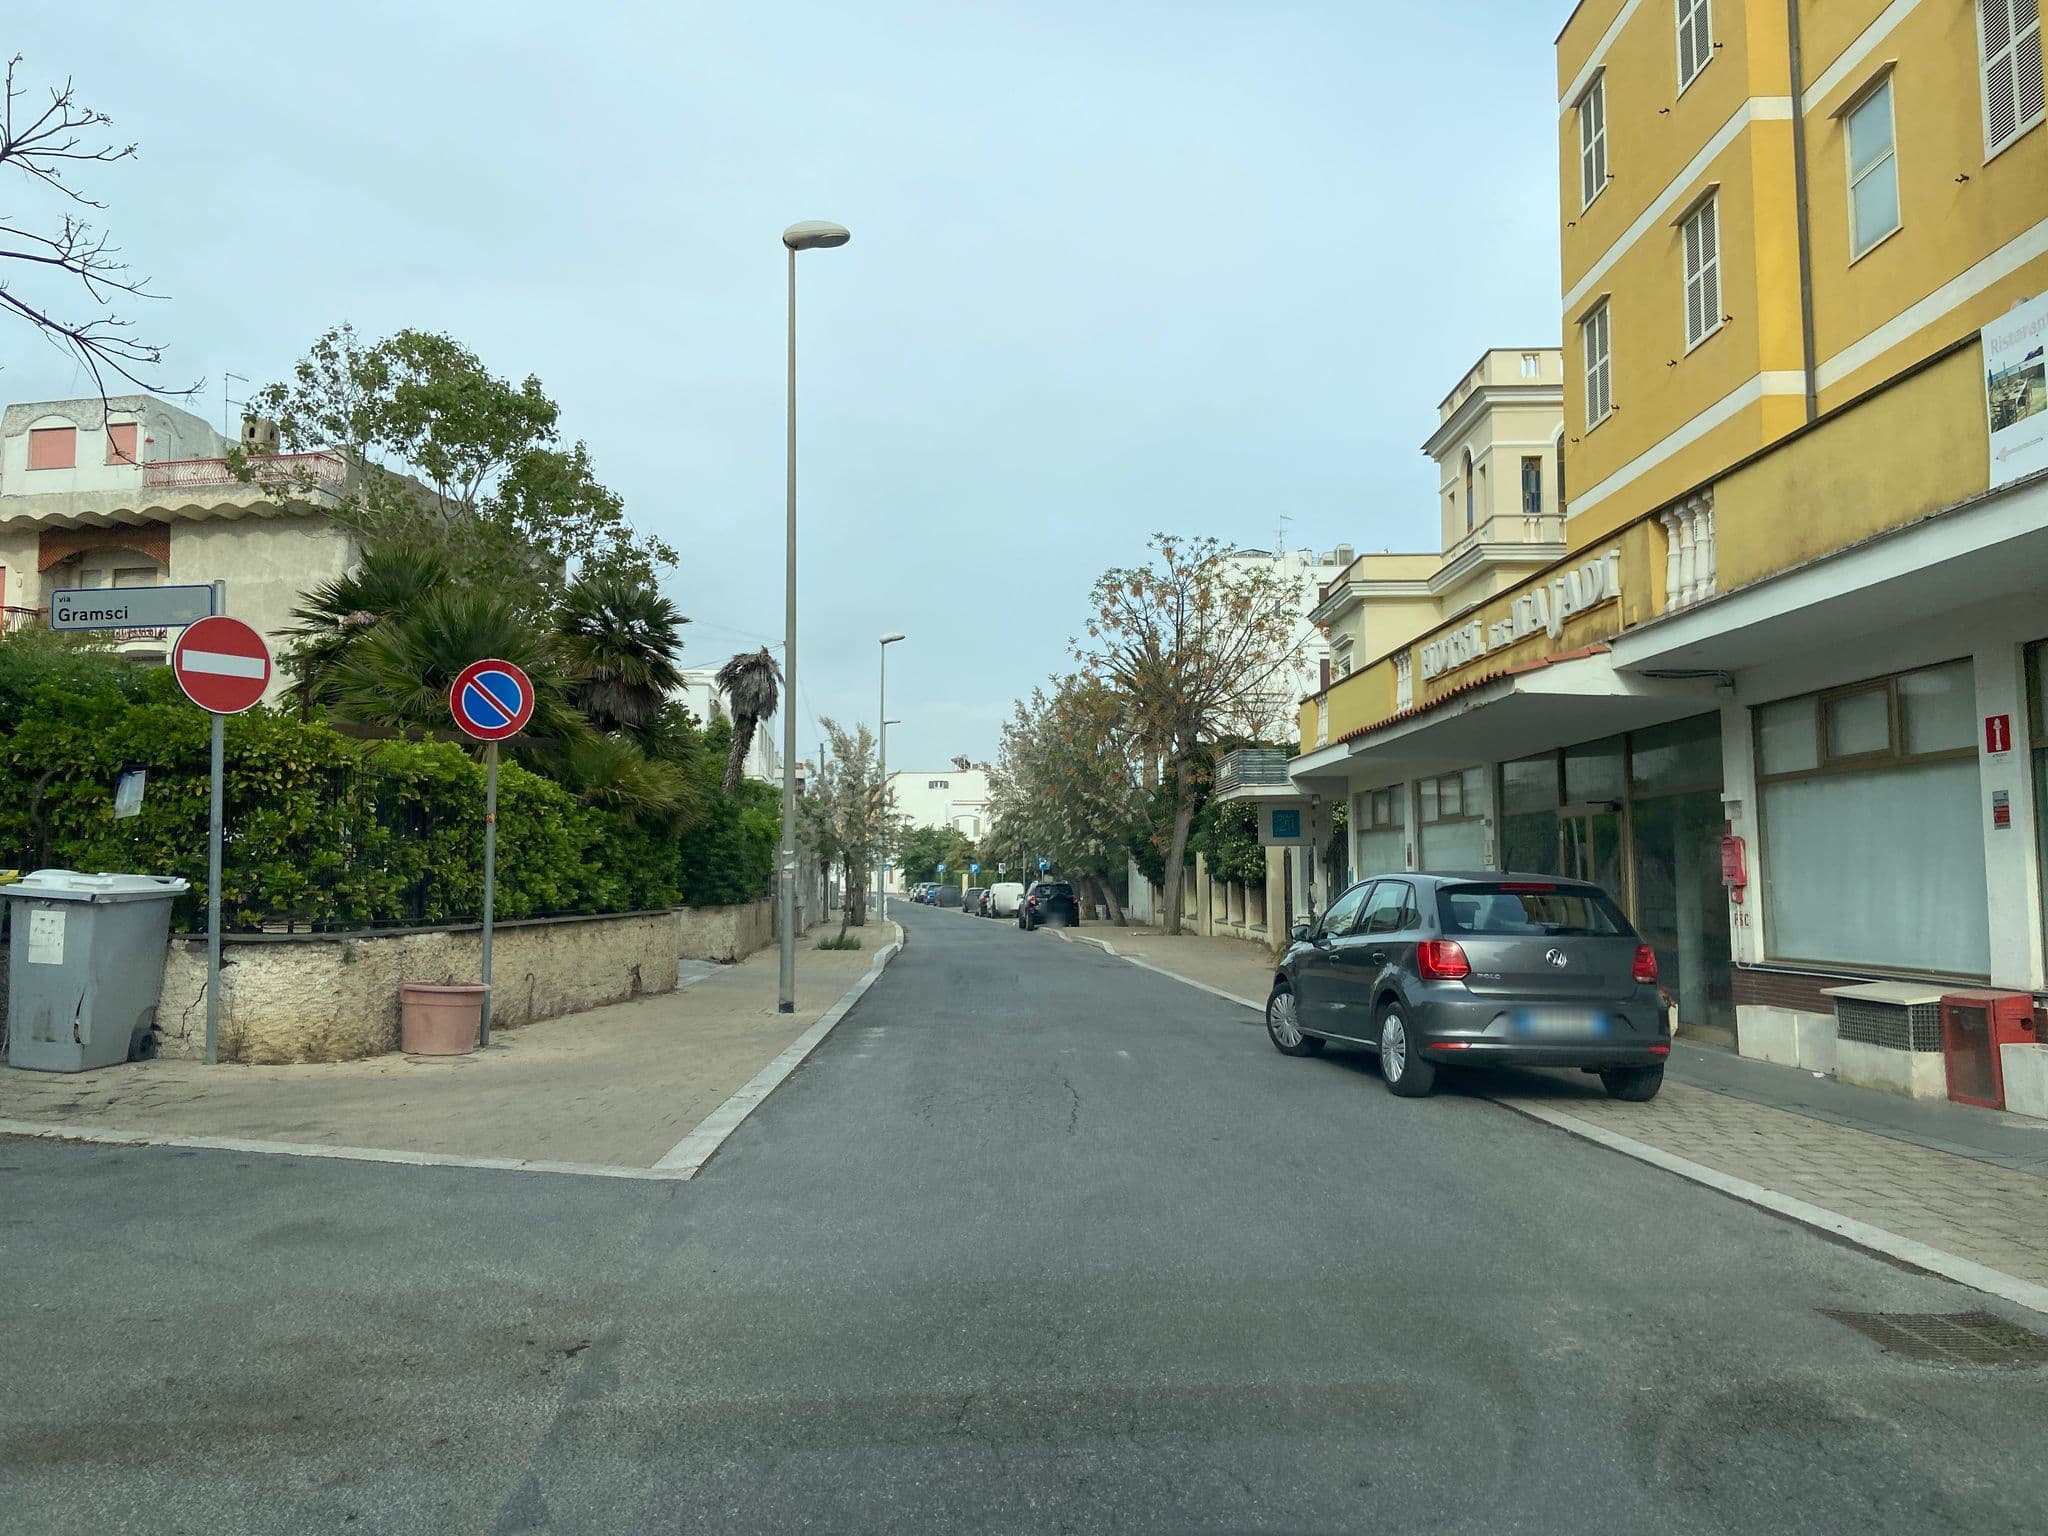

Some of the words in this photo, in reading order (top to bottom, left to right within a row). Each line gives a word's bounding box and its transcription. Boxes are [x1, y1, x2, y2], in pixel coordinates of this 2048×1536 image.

[1990, 312, 2048, 356] Ristoran
[58, 606, 128, 622] Gramsci
[1420, 619, 1487, 681] HOTEL
